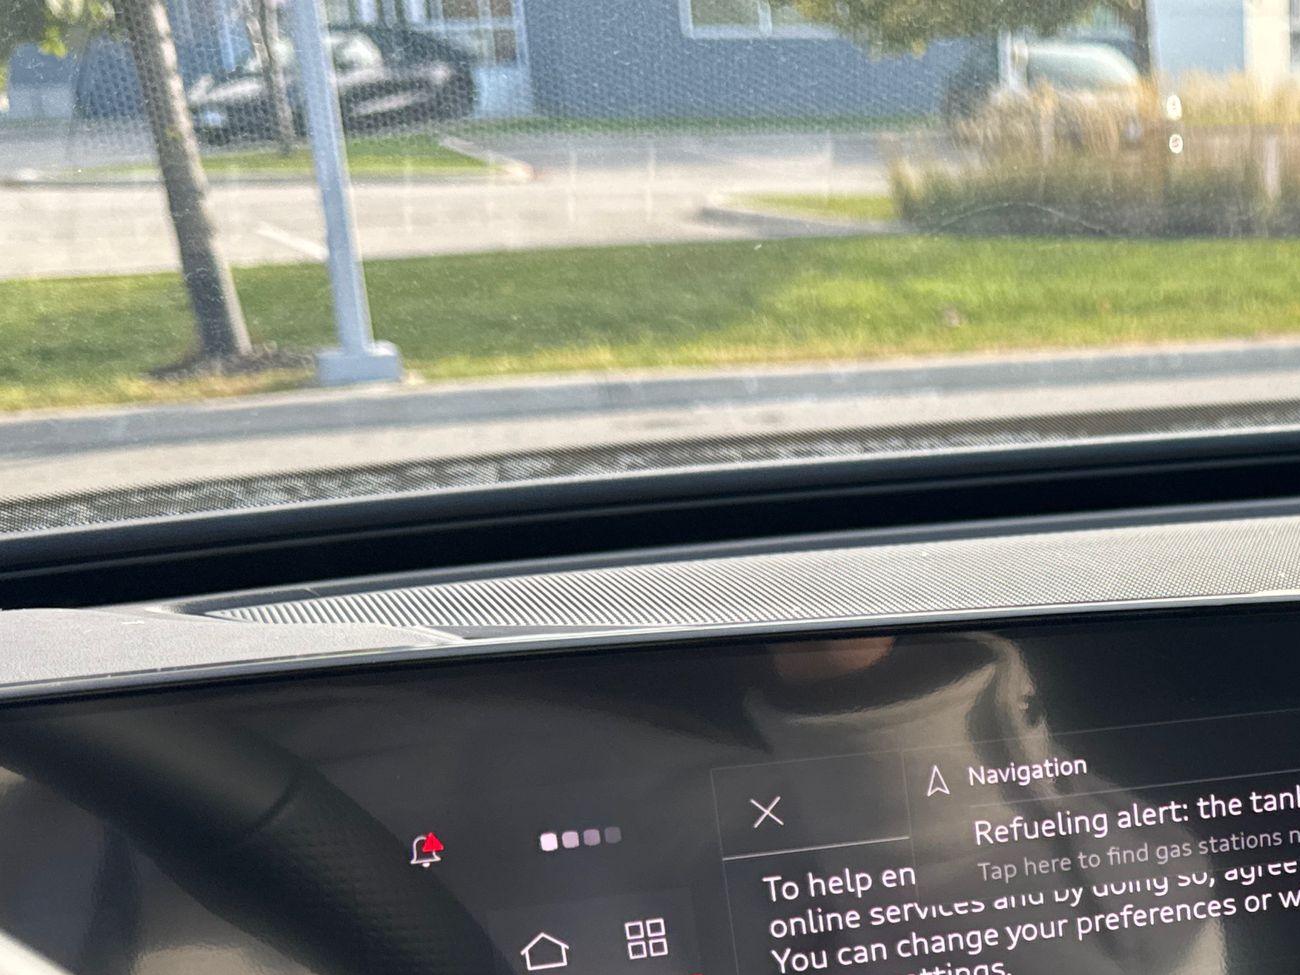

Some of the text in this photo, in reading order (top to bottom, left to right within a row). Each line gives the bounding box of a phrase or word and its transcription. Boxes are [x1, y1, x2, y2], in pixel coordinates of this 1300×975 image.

[969, 759, 1087, 786] Navigation
[974, 812, 1108, 845] Refueling
[1117, 801, 1189, 829] alert:
[1197, 794, 1242, 820] the
[977, 862, 1016, 883] Tap
[1024, 856, 1071, 876] here
[1077, 852, 1100, 869] to
[1107, 843, 1148, 865] find
[1155, 841, 1192, 864] gas
[1200, 831, 1282, 853] stations
[762, 876, 799, 902] To
[808, 868, 872, 897] help
[770, 908, 860, 938] online
[870, 900, 984, 925] services
[772, 948, 828, 974] You
[837, 942, 888, 966] can
[897, 928, 999, 957] change
[1005, 918, 1068, 950] your
[1077, 897, 1236, 941] preferences
[1244, 892, 1272, 913] or
